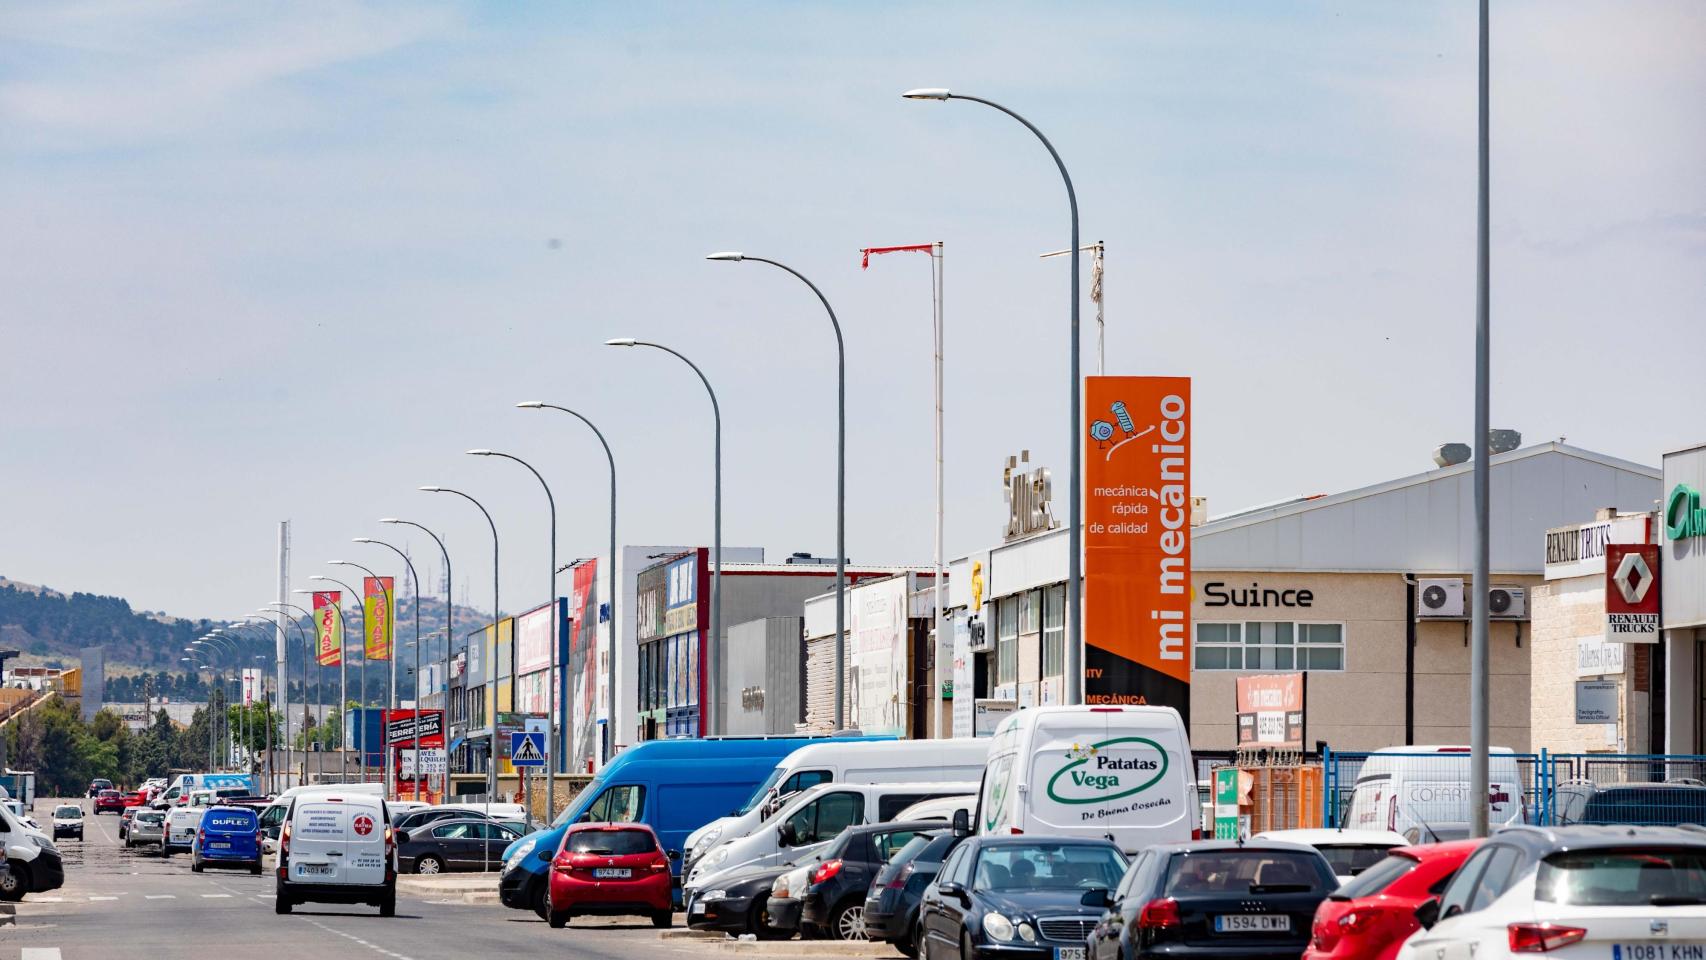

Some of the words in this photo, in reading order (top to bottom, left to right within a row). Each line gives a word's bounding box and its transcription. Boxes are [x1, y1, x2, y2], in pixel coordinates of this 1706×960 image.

[1094, 484, 1149, 497] mecánica
[1149, 394, 1186, 594] mecánico
[1112, 502, 1149, 516] rápida
[1089, 523, 1104, 534] de
[1107, 523, 1149, 534] calidad
[1546, 529, 1579, 565] RENAULT
[1204, 582, 1314, 607] Suince
[1608, 614, 1658, 624] RENAULT
[1611, 623, 1655, 633] TRUCKS
[1151, 610, 1184, 661] mi
[1086, 668, 1103, 679] ITV
[1086, 693, 1147, 705] MECÁNICA
[1097, 756, 1158, 770] Patatas
[1071, 770, 1119, 790] Vega
[1410, 788, 1472, 802] COFART
[1081, 811, 1095, 821] De
[1098, 806, 1129, 819] Buena
[1131, 798, 1171, 811] Cosecha
[1227, 916, 1257, 929] 1594
[1626, 945, 1665, 960] 1081
[1671, 945, 1703, 960] KHN
